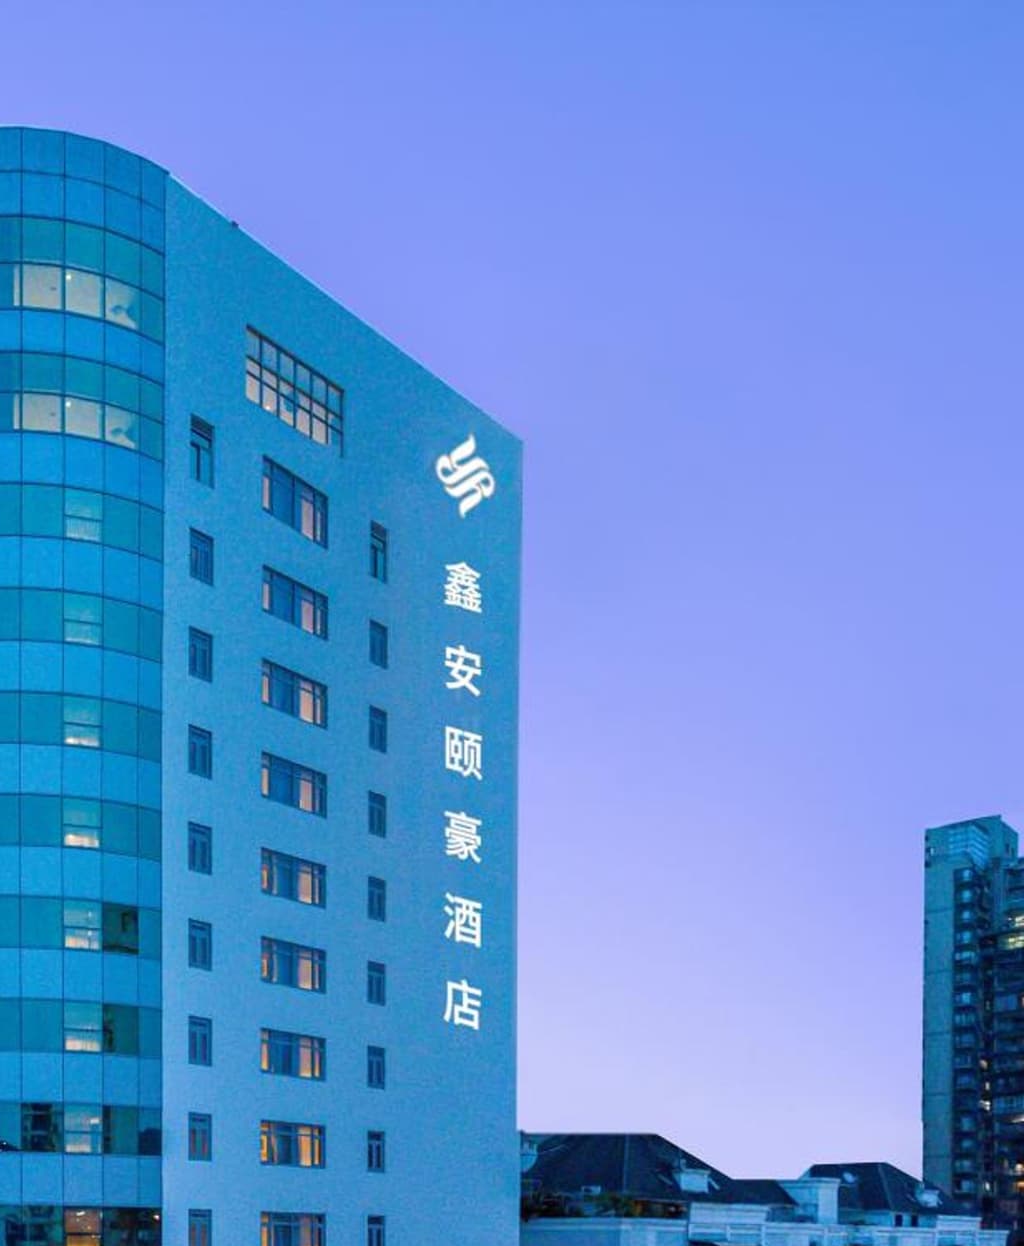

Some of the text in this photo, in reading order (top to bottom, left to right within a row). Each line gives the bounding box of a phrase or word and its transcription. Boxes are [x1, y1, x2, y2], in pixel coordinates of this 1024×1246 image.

[443, 560, 483, 1031] 鑫安颐豪酒店
